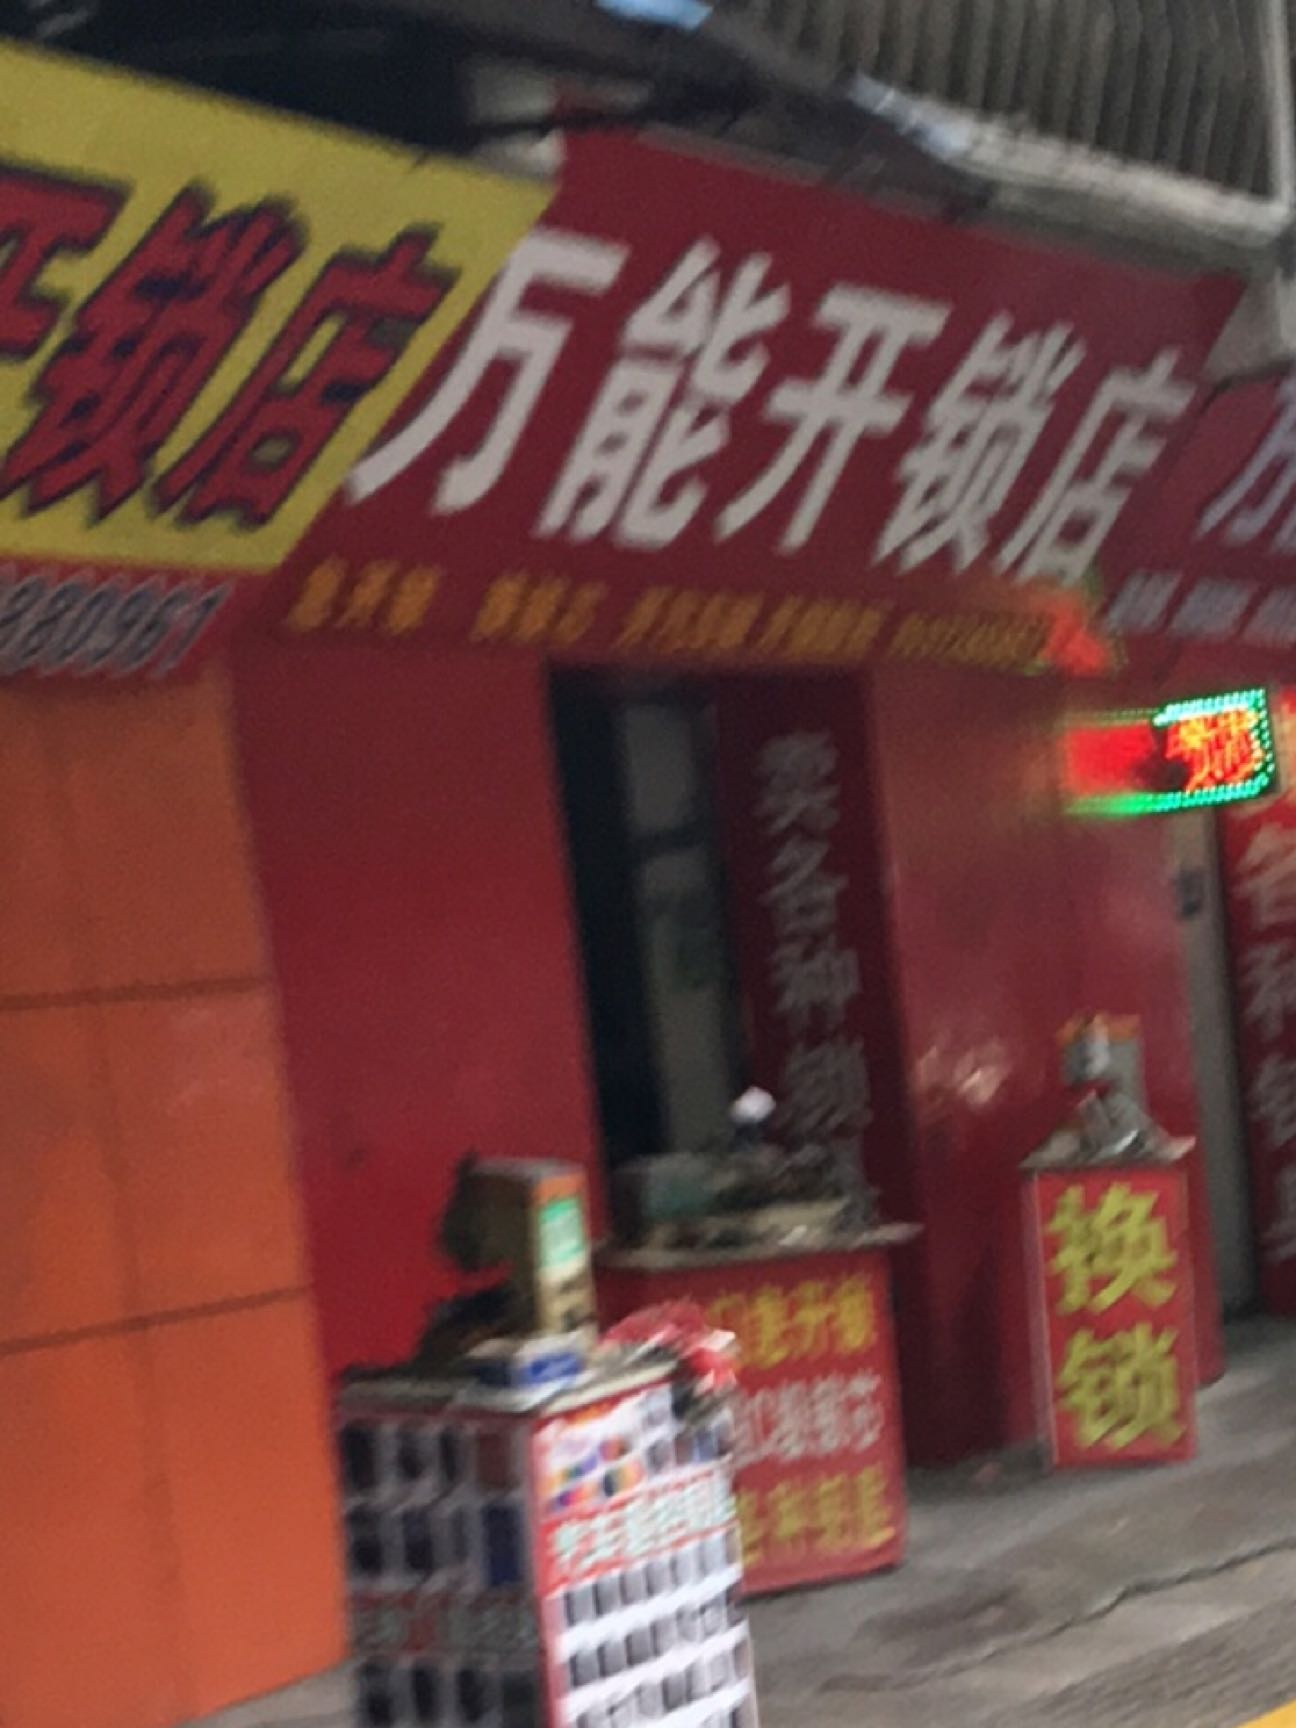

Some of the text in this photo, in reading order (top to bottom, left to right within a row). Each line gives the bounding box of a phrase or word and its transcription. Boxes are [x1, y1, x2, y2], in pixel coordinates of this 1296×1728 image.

[346, 228, 1195, 584] 万能开锁店
[1044, 1181, 1188, 1449] 换锁
